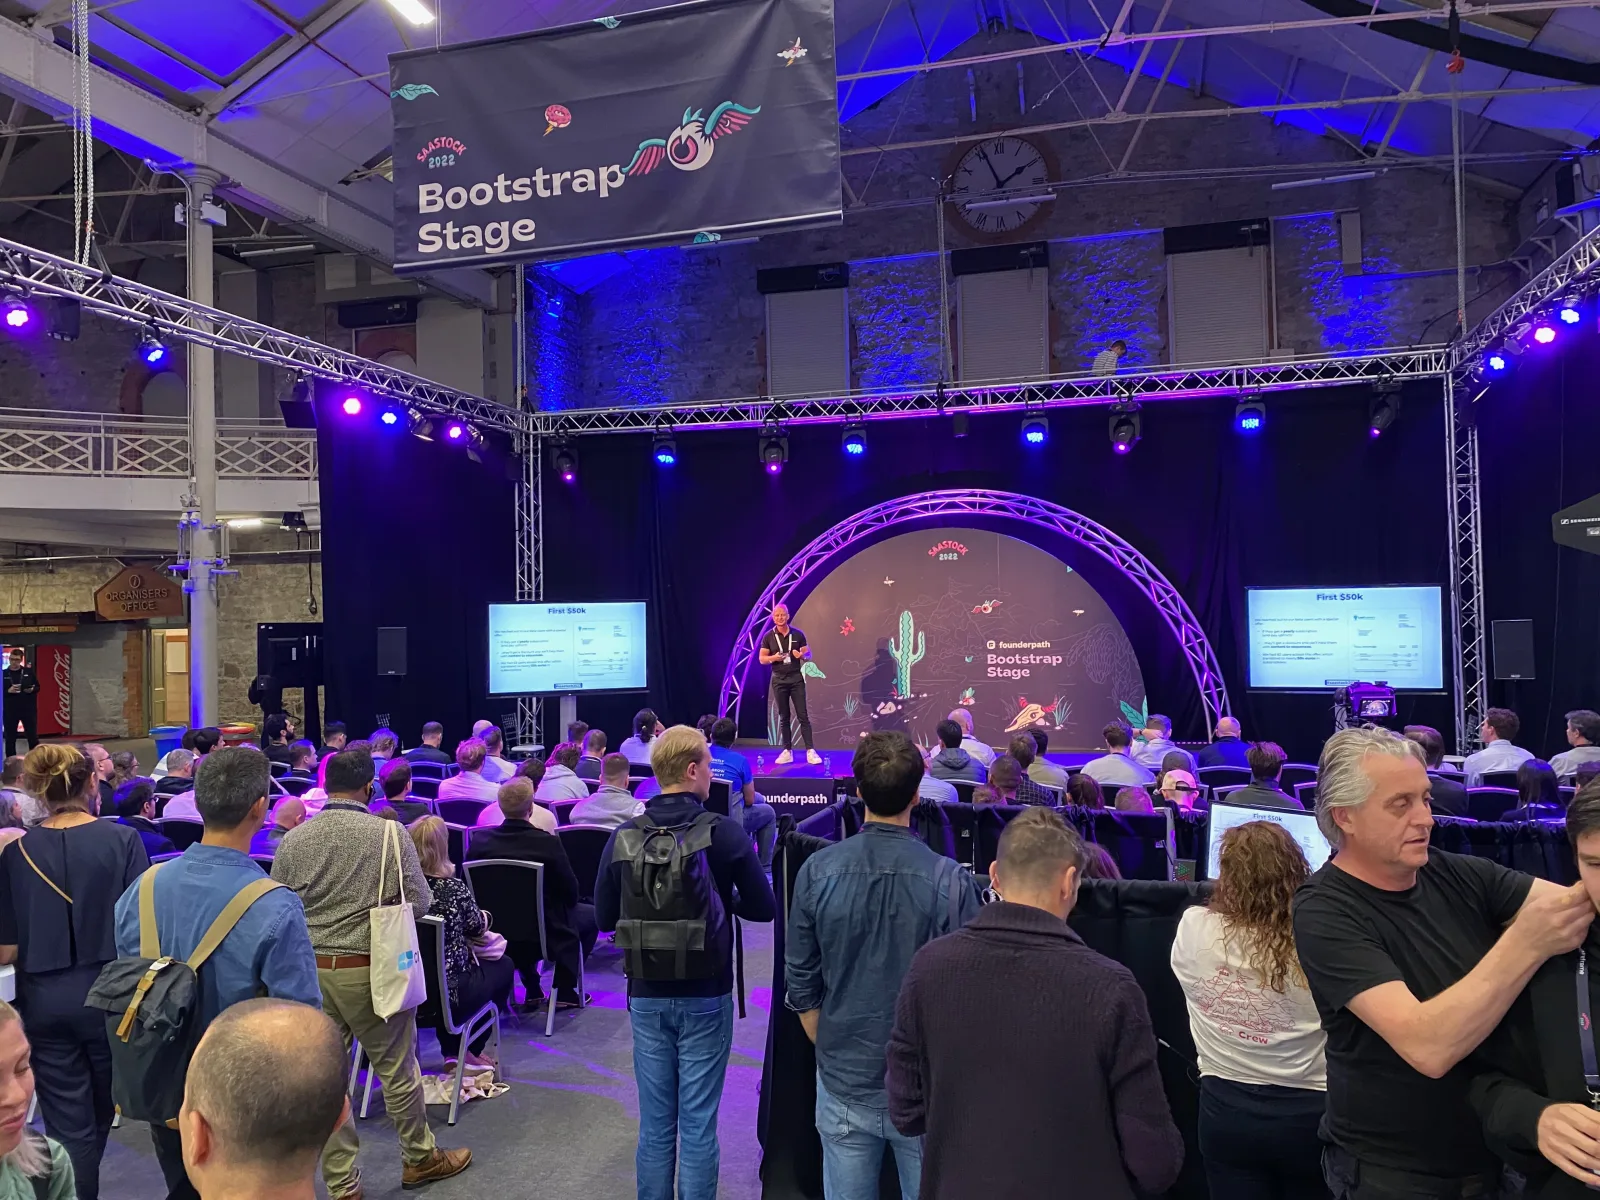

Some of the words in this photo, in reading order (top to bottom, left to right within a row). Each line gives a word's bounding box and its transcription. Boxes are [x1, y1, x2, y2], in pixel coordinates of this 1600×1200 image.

[416, 136, 467, 163] SAASTOCK
[428, 153, 456, 169] 2022
[418, 163, 626, 214] Bootstrap
[417, 217, 536, 254] Stage
[927, 540, 969, 557] SAASTOCK
[939, 552, 958, 561] 2022
[105, 588, 168, 601] ORGANISERS
[1316, 593, 1338, 601] First
[1340, 593, 1363, 601] $50k
[120, 601, 155, 612] OFFICE
[567, 607, 586, 615] $50k
[999, 640, 1051, 650] founderpath
[987, 653, 1063, 667] Bootstrap
[987, 666, 1030, 680] Stage
[1238, 1031, 1268, 1045] Crew
